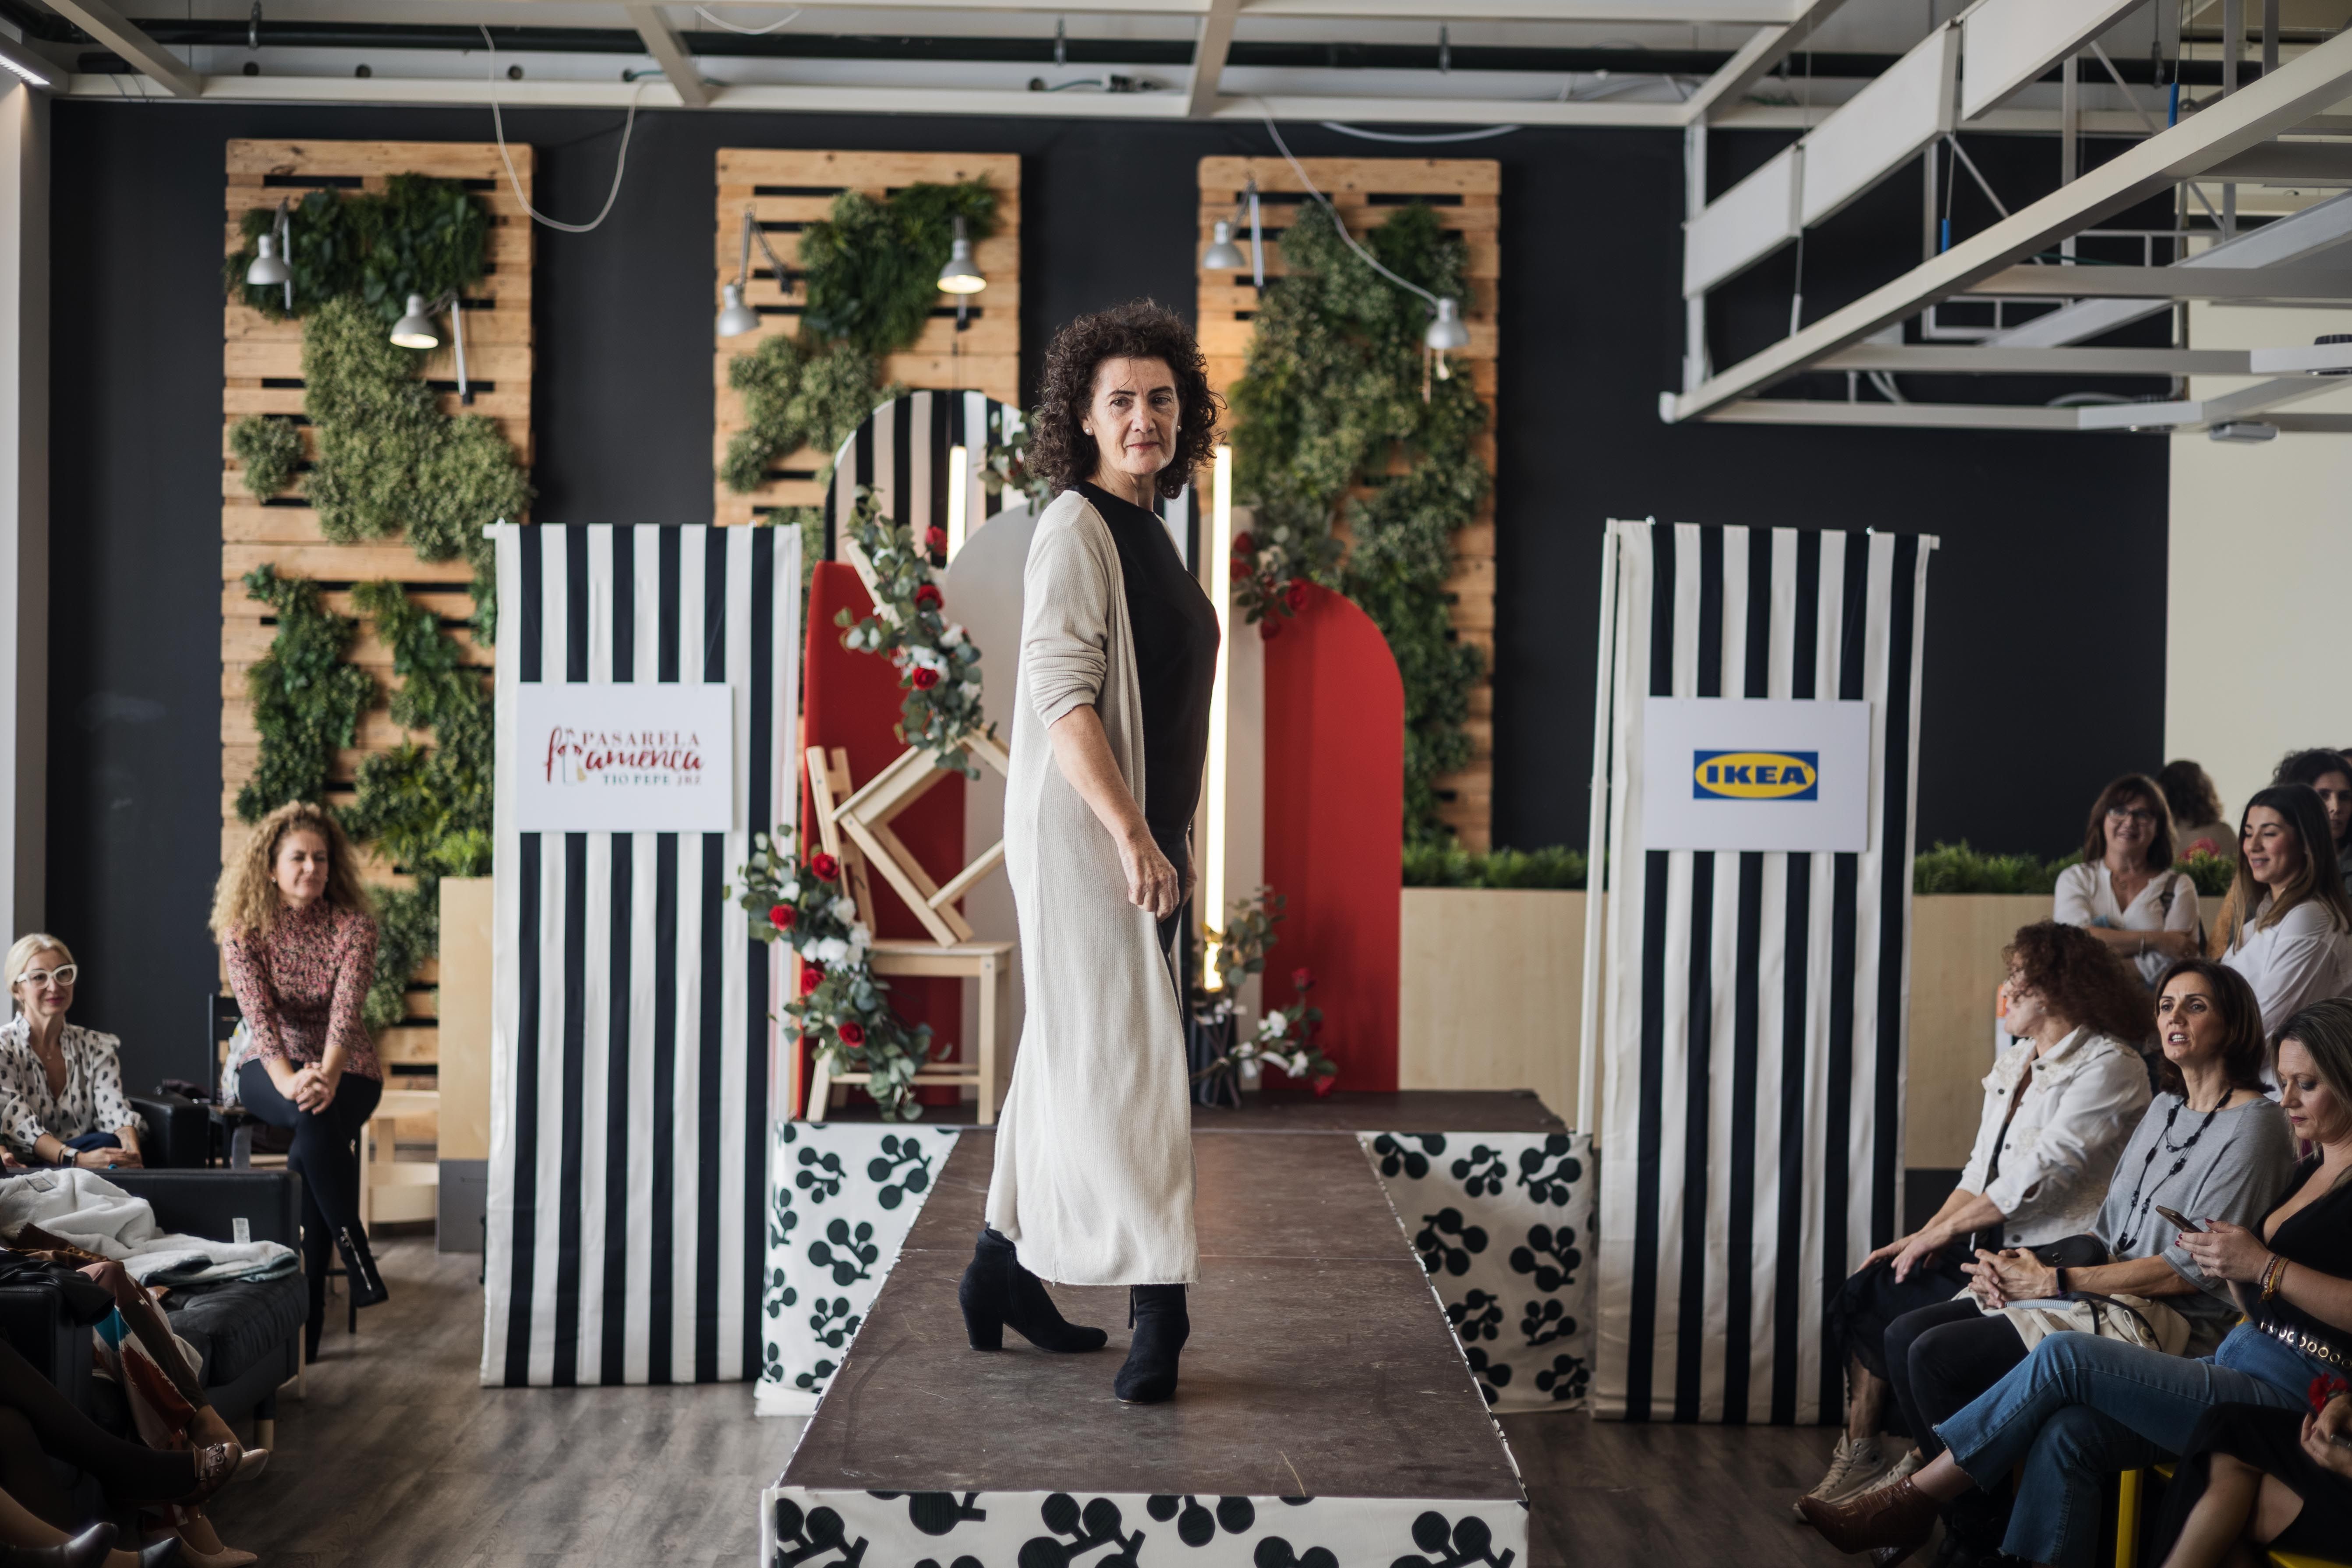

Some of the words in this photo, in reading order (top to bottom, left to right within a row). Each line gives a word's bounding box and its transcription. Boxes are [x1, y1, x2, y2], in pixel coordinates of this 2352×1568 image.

[582, 730, 700, 746] PASARELA
[603, 774, 630, 786] TIO
[634, 774, 669, 786] PEPE
[1707, 765, 1807, 785] IKEA
